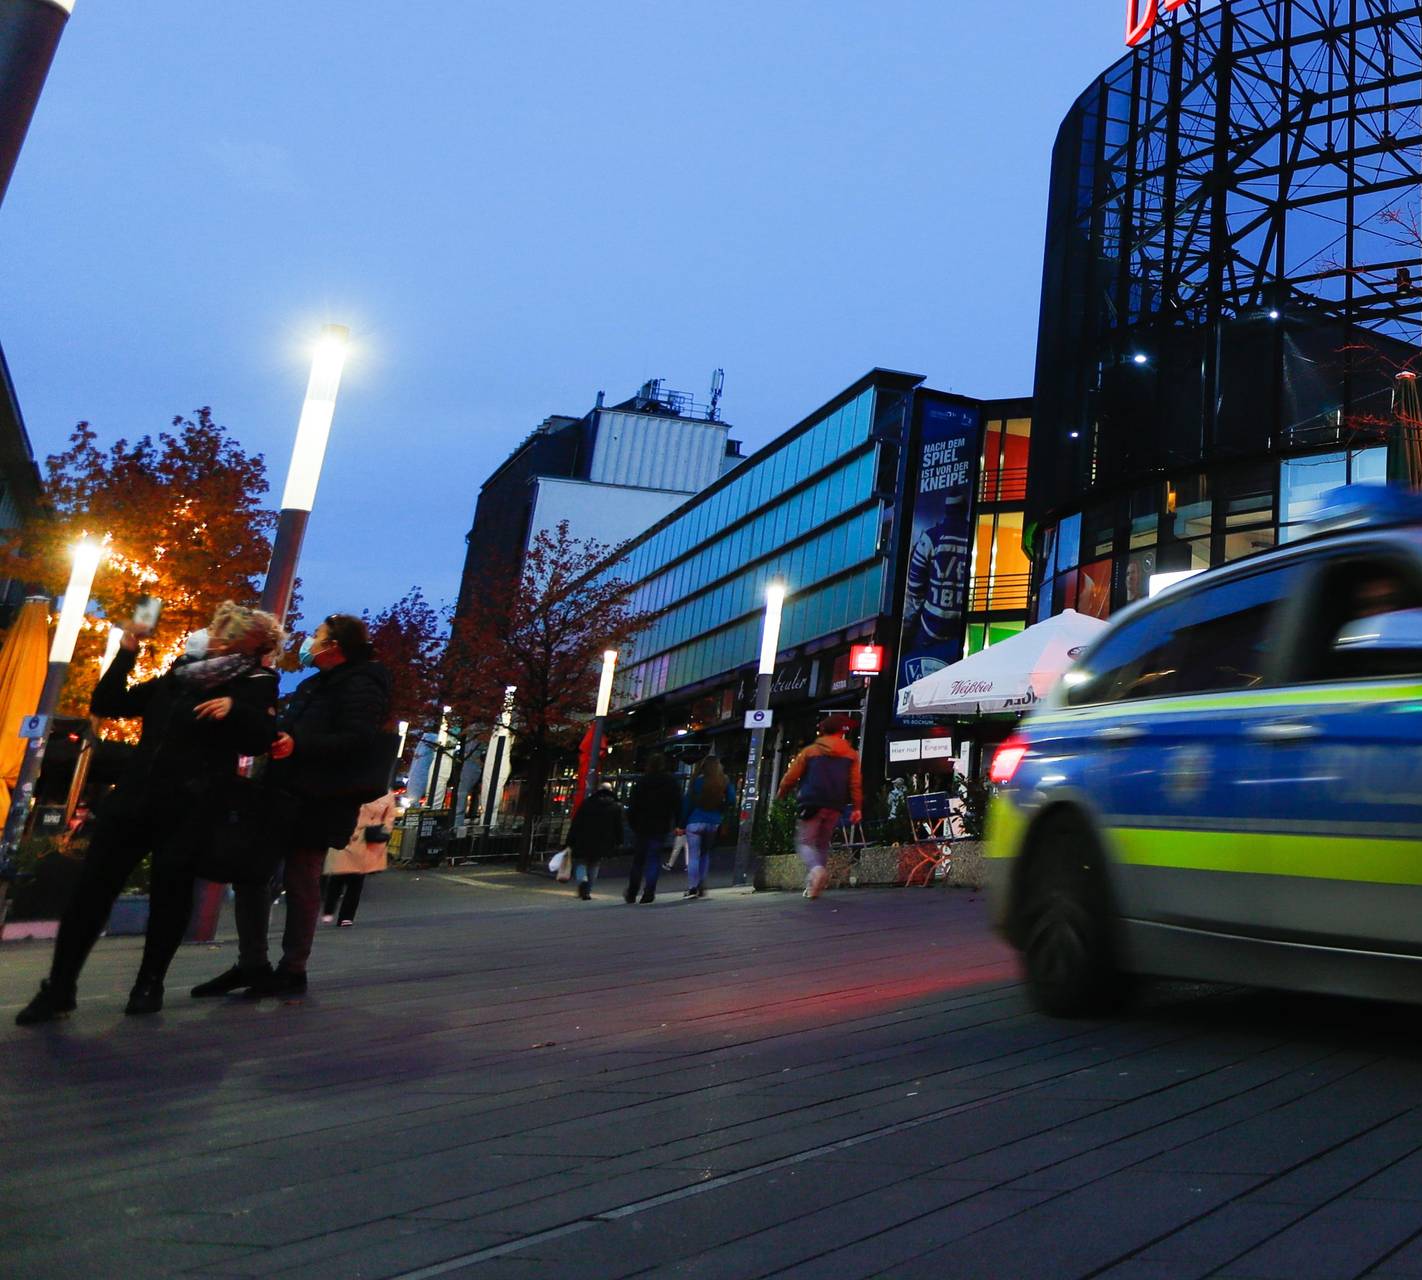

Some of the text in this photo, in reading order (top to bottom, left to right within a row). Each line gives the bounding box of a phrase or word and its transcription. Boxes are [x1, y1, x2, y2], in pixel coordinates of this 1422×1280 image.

[924, 438, 965, 453] NACH DEM
[922, 448, 958, 467] SPIEL
[921, 461, 969, 478] IST VOR DER
[920, 471, 968, 493] KNEIPE.
[951, 679, 993, 698] Weißbier
